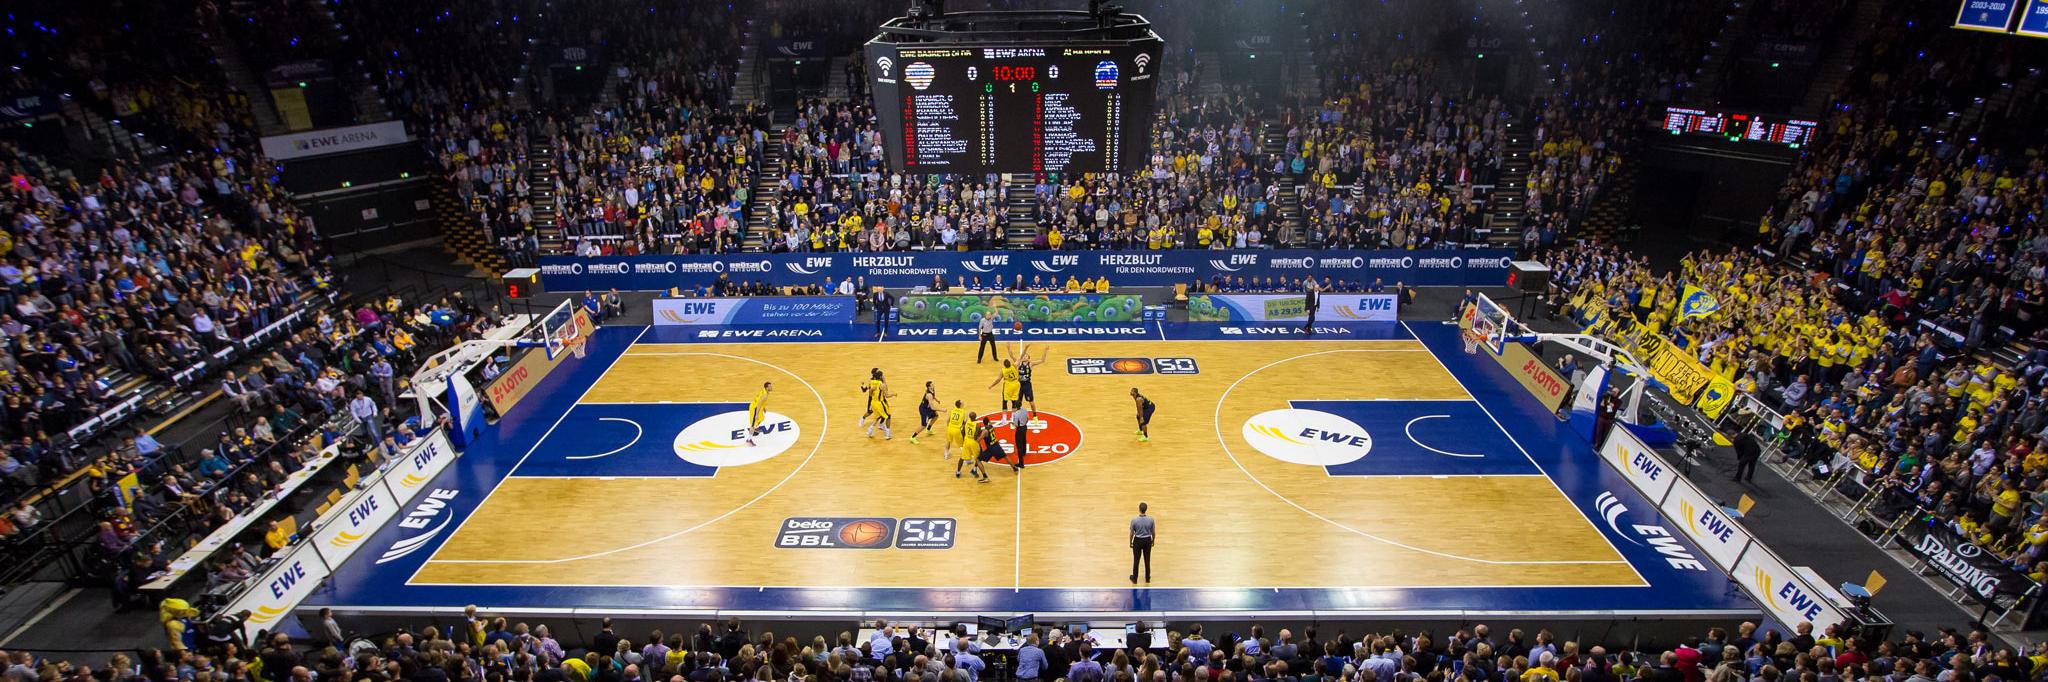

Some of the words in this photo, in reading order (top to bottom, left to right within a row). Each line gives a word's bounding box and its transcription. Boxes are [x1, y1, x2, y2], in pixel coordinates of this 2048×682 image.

[992, 66, 1035, 80] 10:00
[312, 136, 339, 148] EWE
[806, 257, 832, 267] EWE
[853, 256, 914, 266] HERZBLUT
[982, 255, 1008, 265] EWE
[1052, 255, 1079, 265] EWE
[1100, 255, 1162, 265] HERZBLUT
[1230, 255, 1257, 264] EWE
[684, 302, 716, 314] EWE
[1359, 298, 1392, 310] EWE
[501, 366, 528, 394] LOTTO
[1533, 368, 1561, 396] LOTTO
[731, 421, 791, 440] EWE
[1299, 428, 1368, 447] EWE
[414, 442, 438, 471] EWE
[1633, 452, 1662, 481] EWE
[350, 495, 378, 528] EWE
[398, 488, 459, 529] EWE
[788, 520, 833, 529] beko
[903, 520, 952, 542] 50
[1700, 510, 1733, 543] EWE
[780, 535, 835, 546] BBL
[1632, 524, 1707, 571] EWE
[1914, 534, 2000, 598] SPALDING
[270, 560, 306, 599] EWE
[1779, 582, 1822, 621] EWE
